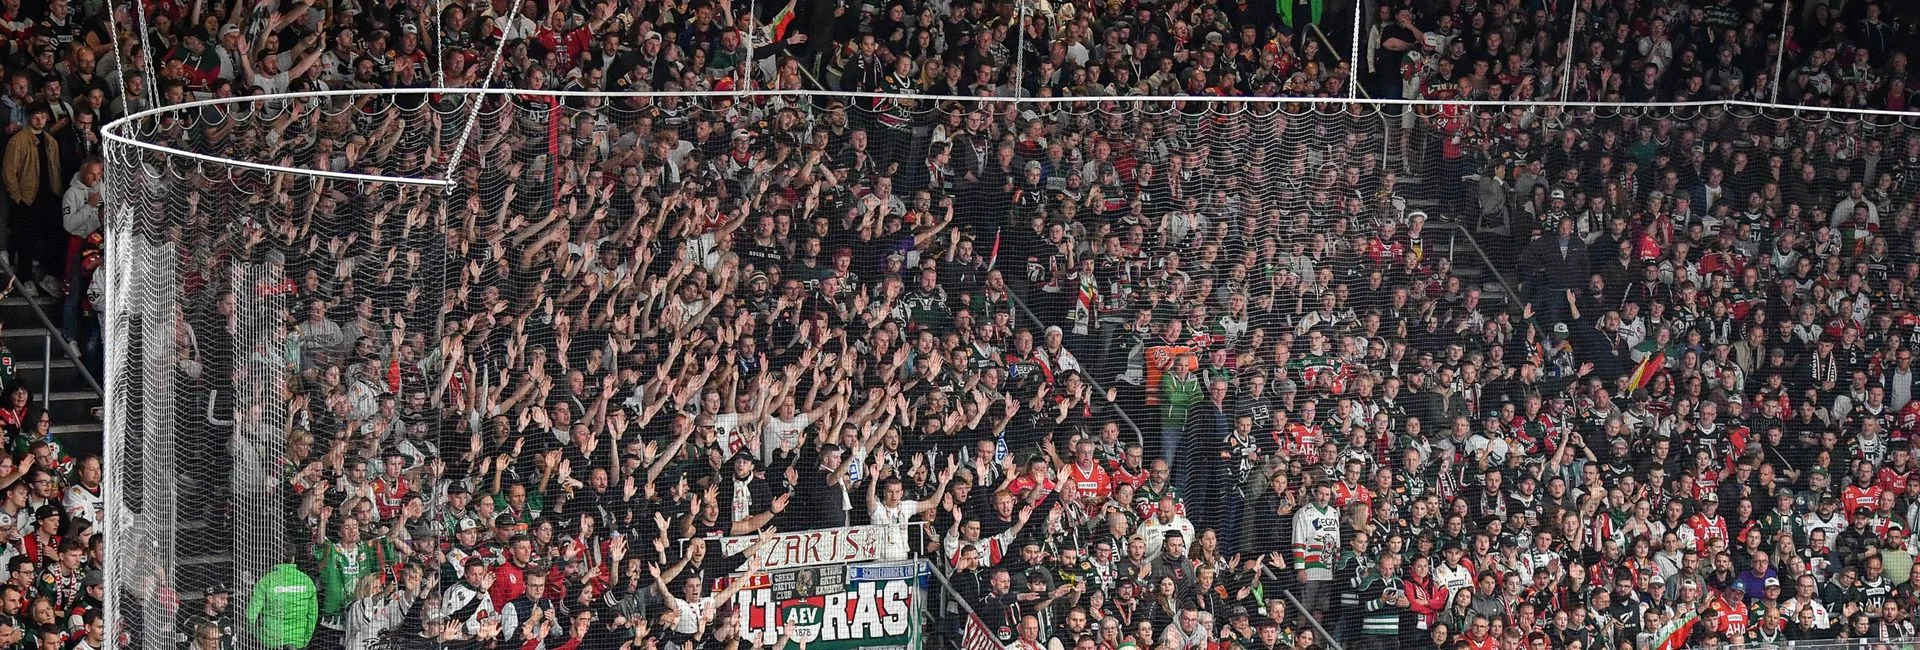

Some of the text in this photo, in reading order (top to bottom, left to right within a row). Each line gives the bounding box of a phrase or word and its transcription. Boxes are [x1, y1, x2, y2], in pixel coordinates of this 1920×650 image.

[774, 572, 795, 582] GREEN
[773, 581, 796, 592] GHETTO
[776, 590, 793, 600] CLUB
[787, 607, 818, 624] AEV
[795, 628, 811, 637] 1878
